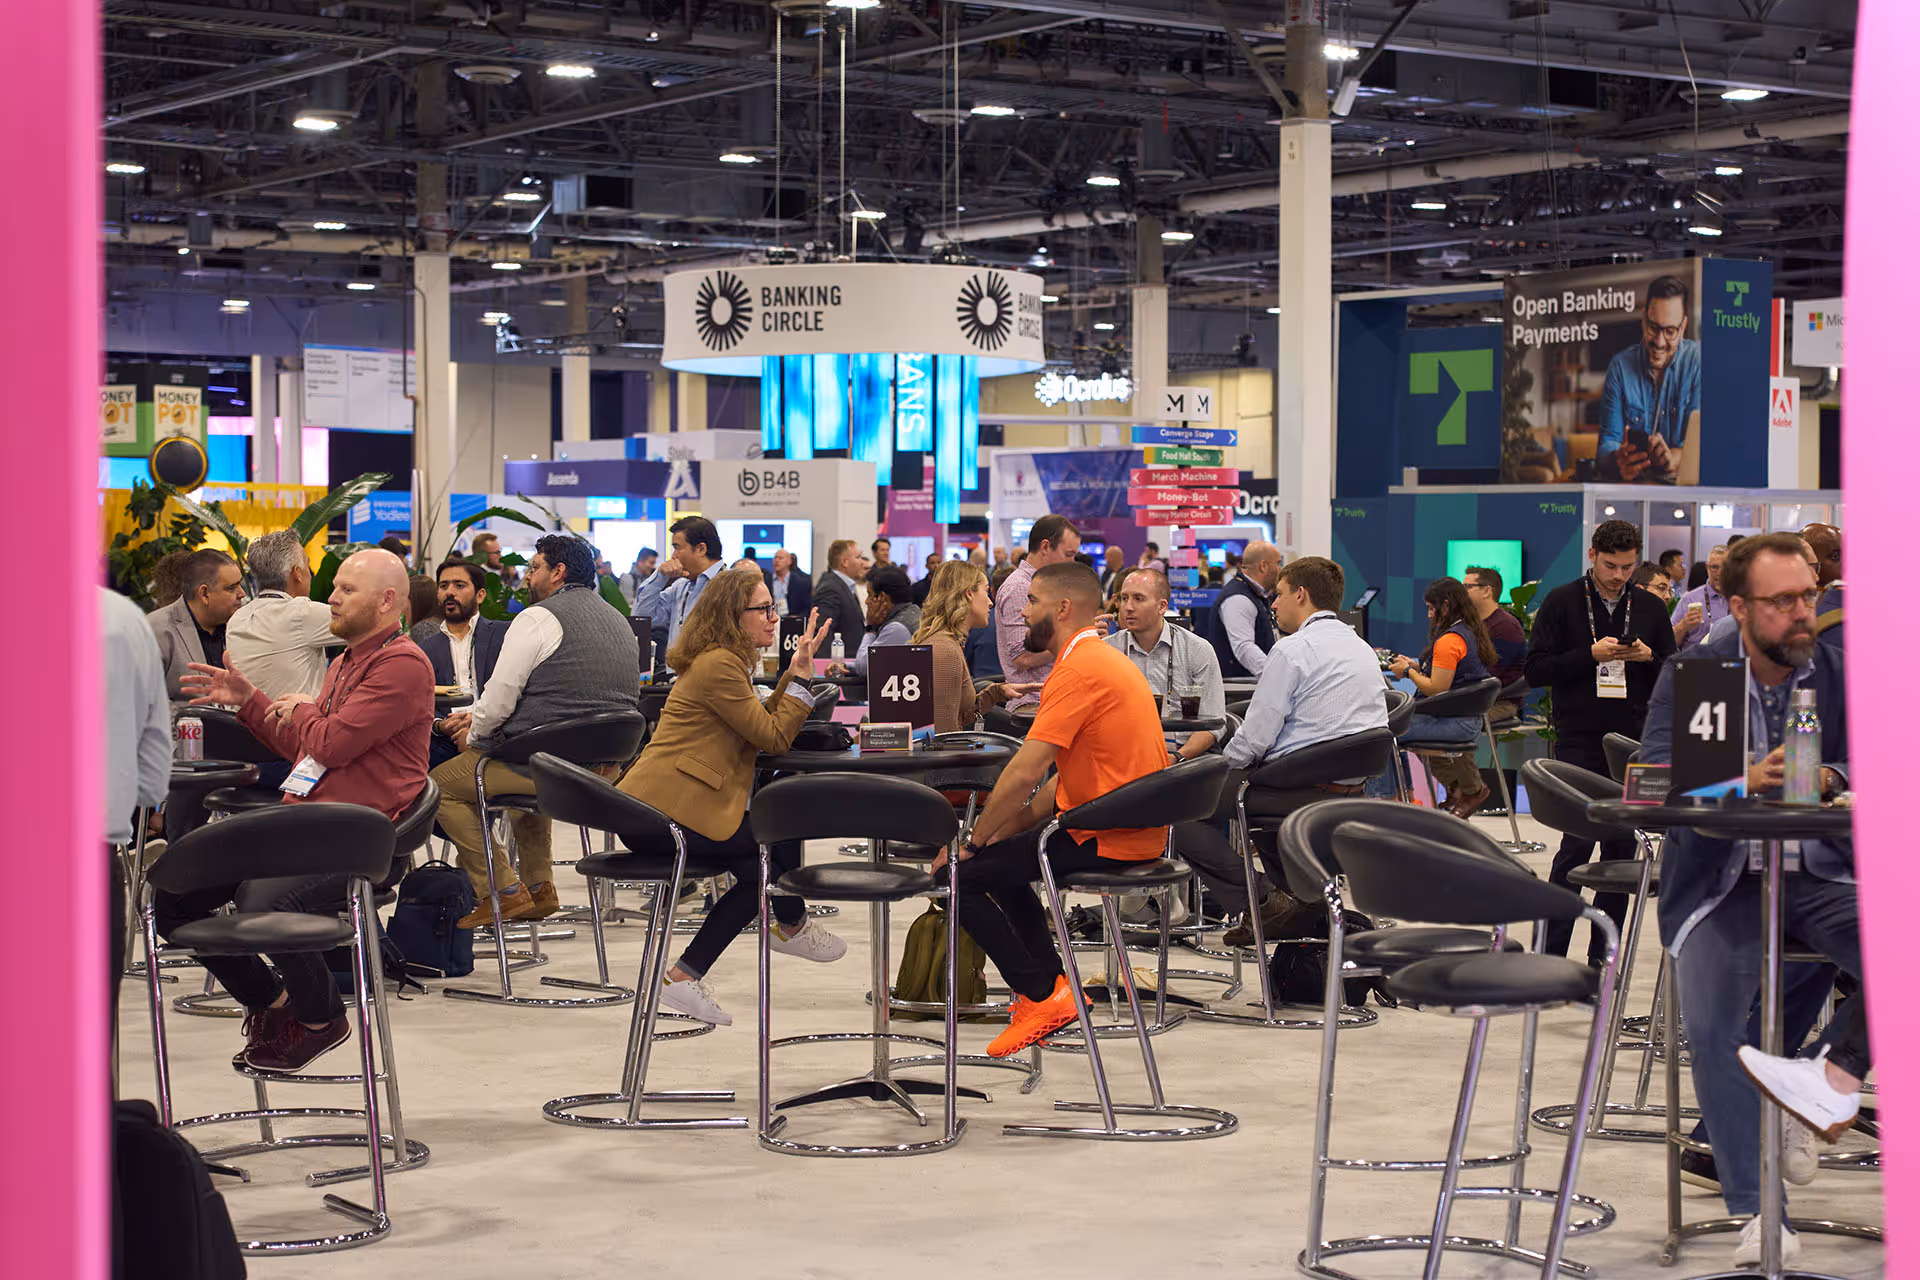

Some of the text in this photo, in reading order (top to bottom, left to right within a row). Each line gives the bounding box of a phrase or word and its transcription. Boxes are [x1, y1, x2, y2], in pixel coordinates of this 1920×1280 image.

[761, 285, 842, 307] BANKING
[1512, 286, 1636, 320] Open Banking
[762, 310, 825, 332] CIRCLE
[1713, 309, 1761, 333] Trustly
[1512, 321, 1600, 349] Payments
[158, 391, 199, 405] MONEY
[158, 402, 199, 425] POT
[1772, 417, 1793, 428] Adobe
[1160, 428, 1215, 440] Converge Stage
[1162, 451, 1178, 461] Food
[1179, 452, 1192, 461] Hall
[763, 470, 801, 489] B4B
[1152, 471, 1218, 482] Merch Machine
[1157, 491, 1209, 503] Money-Bot
[1149, 511, 1170, 520] Money
[1190, 511, 1212, 519] Circuit
[1344, 507, 1367, 520] Trustly
[1551, 503, 1576, 516] Trustly
[783, 633, 800, 651] 68
[880, 674, 922, 702] 48
[1688, 701, 1728, 742] 41
